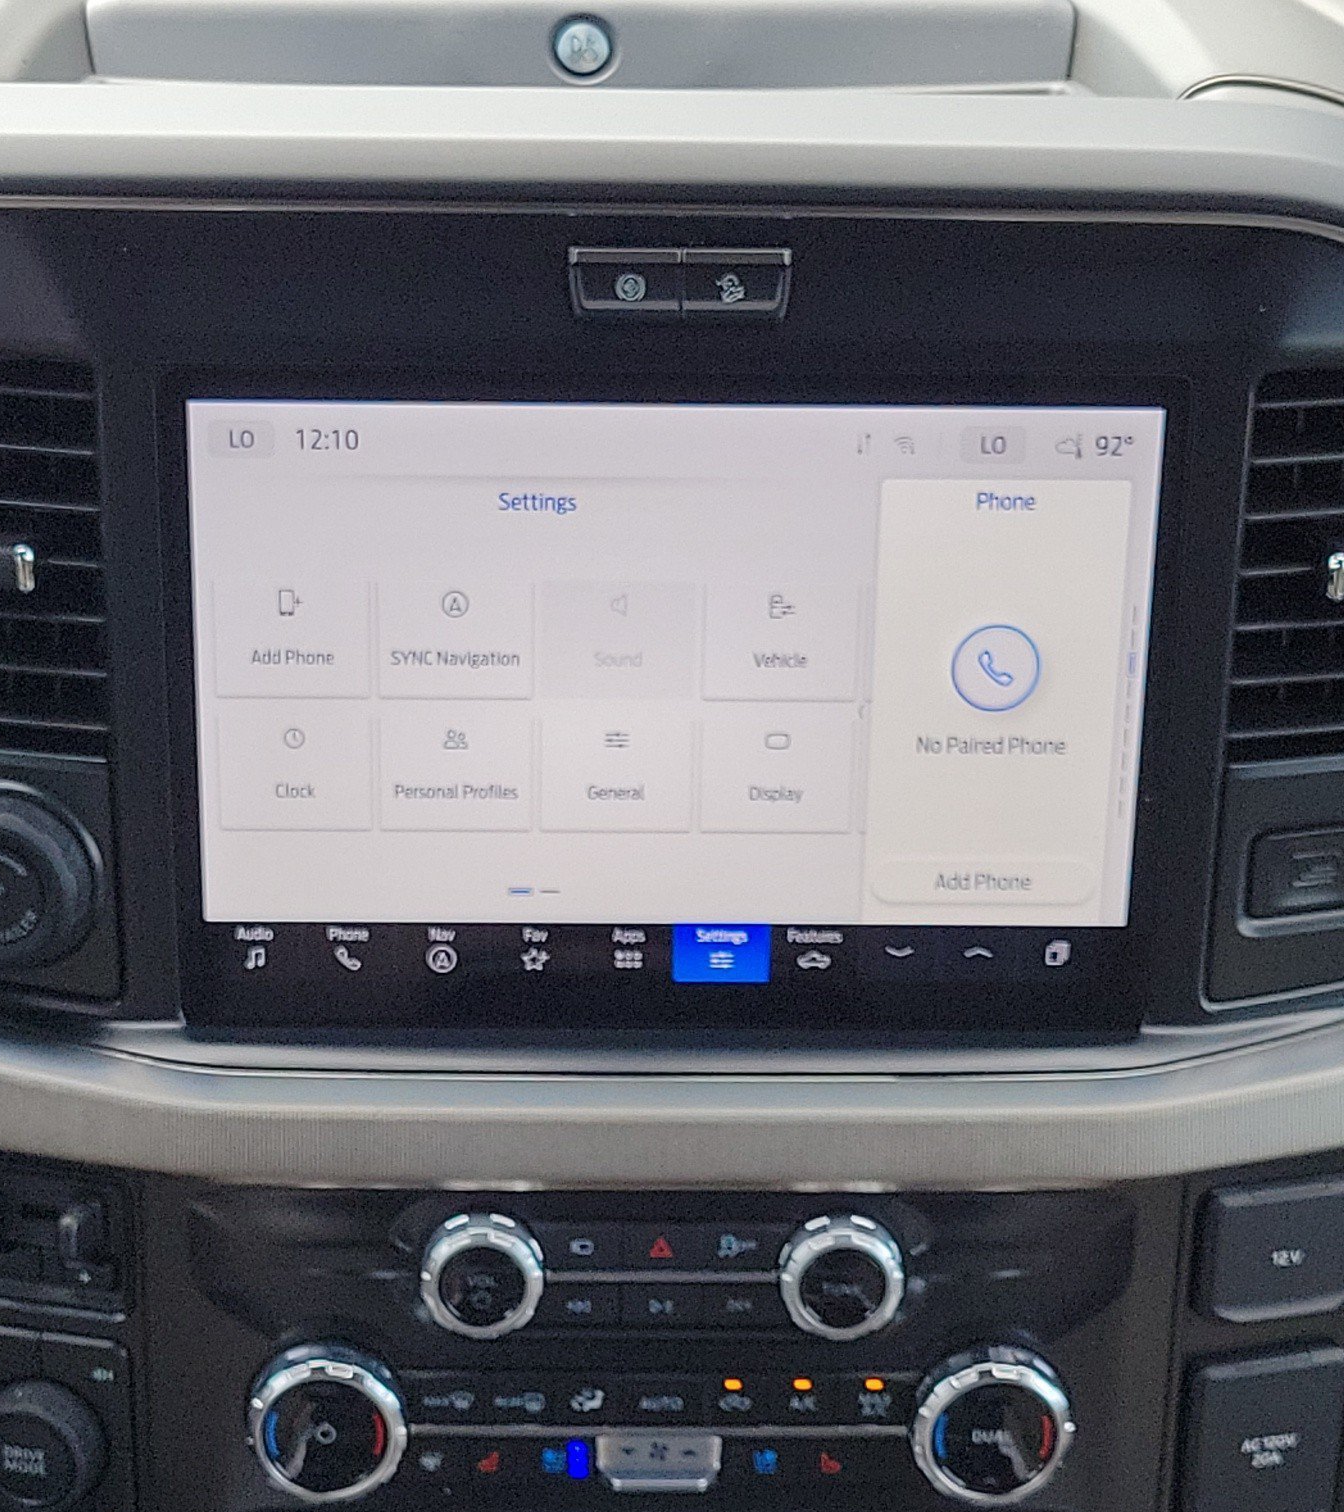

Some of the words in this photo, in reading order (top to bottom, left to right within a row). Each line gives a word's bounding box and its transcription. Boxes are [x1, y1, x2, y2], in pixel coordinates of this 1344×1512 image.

[229, 429, 255, 450] LO
[295, 428, 360, 451] 12:10
[497, 492, 577, 515] Settings
[976, 491, 1037, 512] Phone
[252, 648, 281, 666] Add
[285, 648, 335, 666] Phone
[389, 649, 434, 668] SYNC
[436, 649, 521, 670] Navigation
[594, 650, 644, 668] Sound
[753, 651, 809, 670] Vehicle
[915, 735, 942, 755] No
[947, 735, 1004, 755] Paired
[1008, 736, 1067, 756] Phone
[275, 782, 316, 799] Clock
[394, 783, 458, 801] Personal
[462, 783, 520, 801] Profiles
[587, 784, 646, 802] General
[748, 784, 804, 804] Display
[934, 873, 970, 892] Add
[975, 873, 1032, 892] Phone
[234, 926, 274, 943] Audio
[325, 926, 370, 944] Phone
[427, 927, 456, 943] Nav
[611, 928, 646, 946] Apps
[694, 928, 750, 946] Settings
